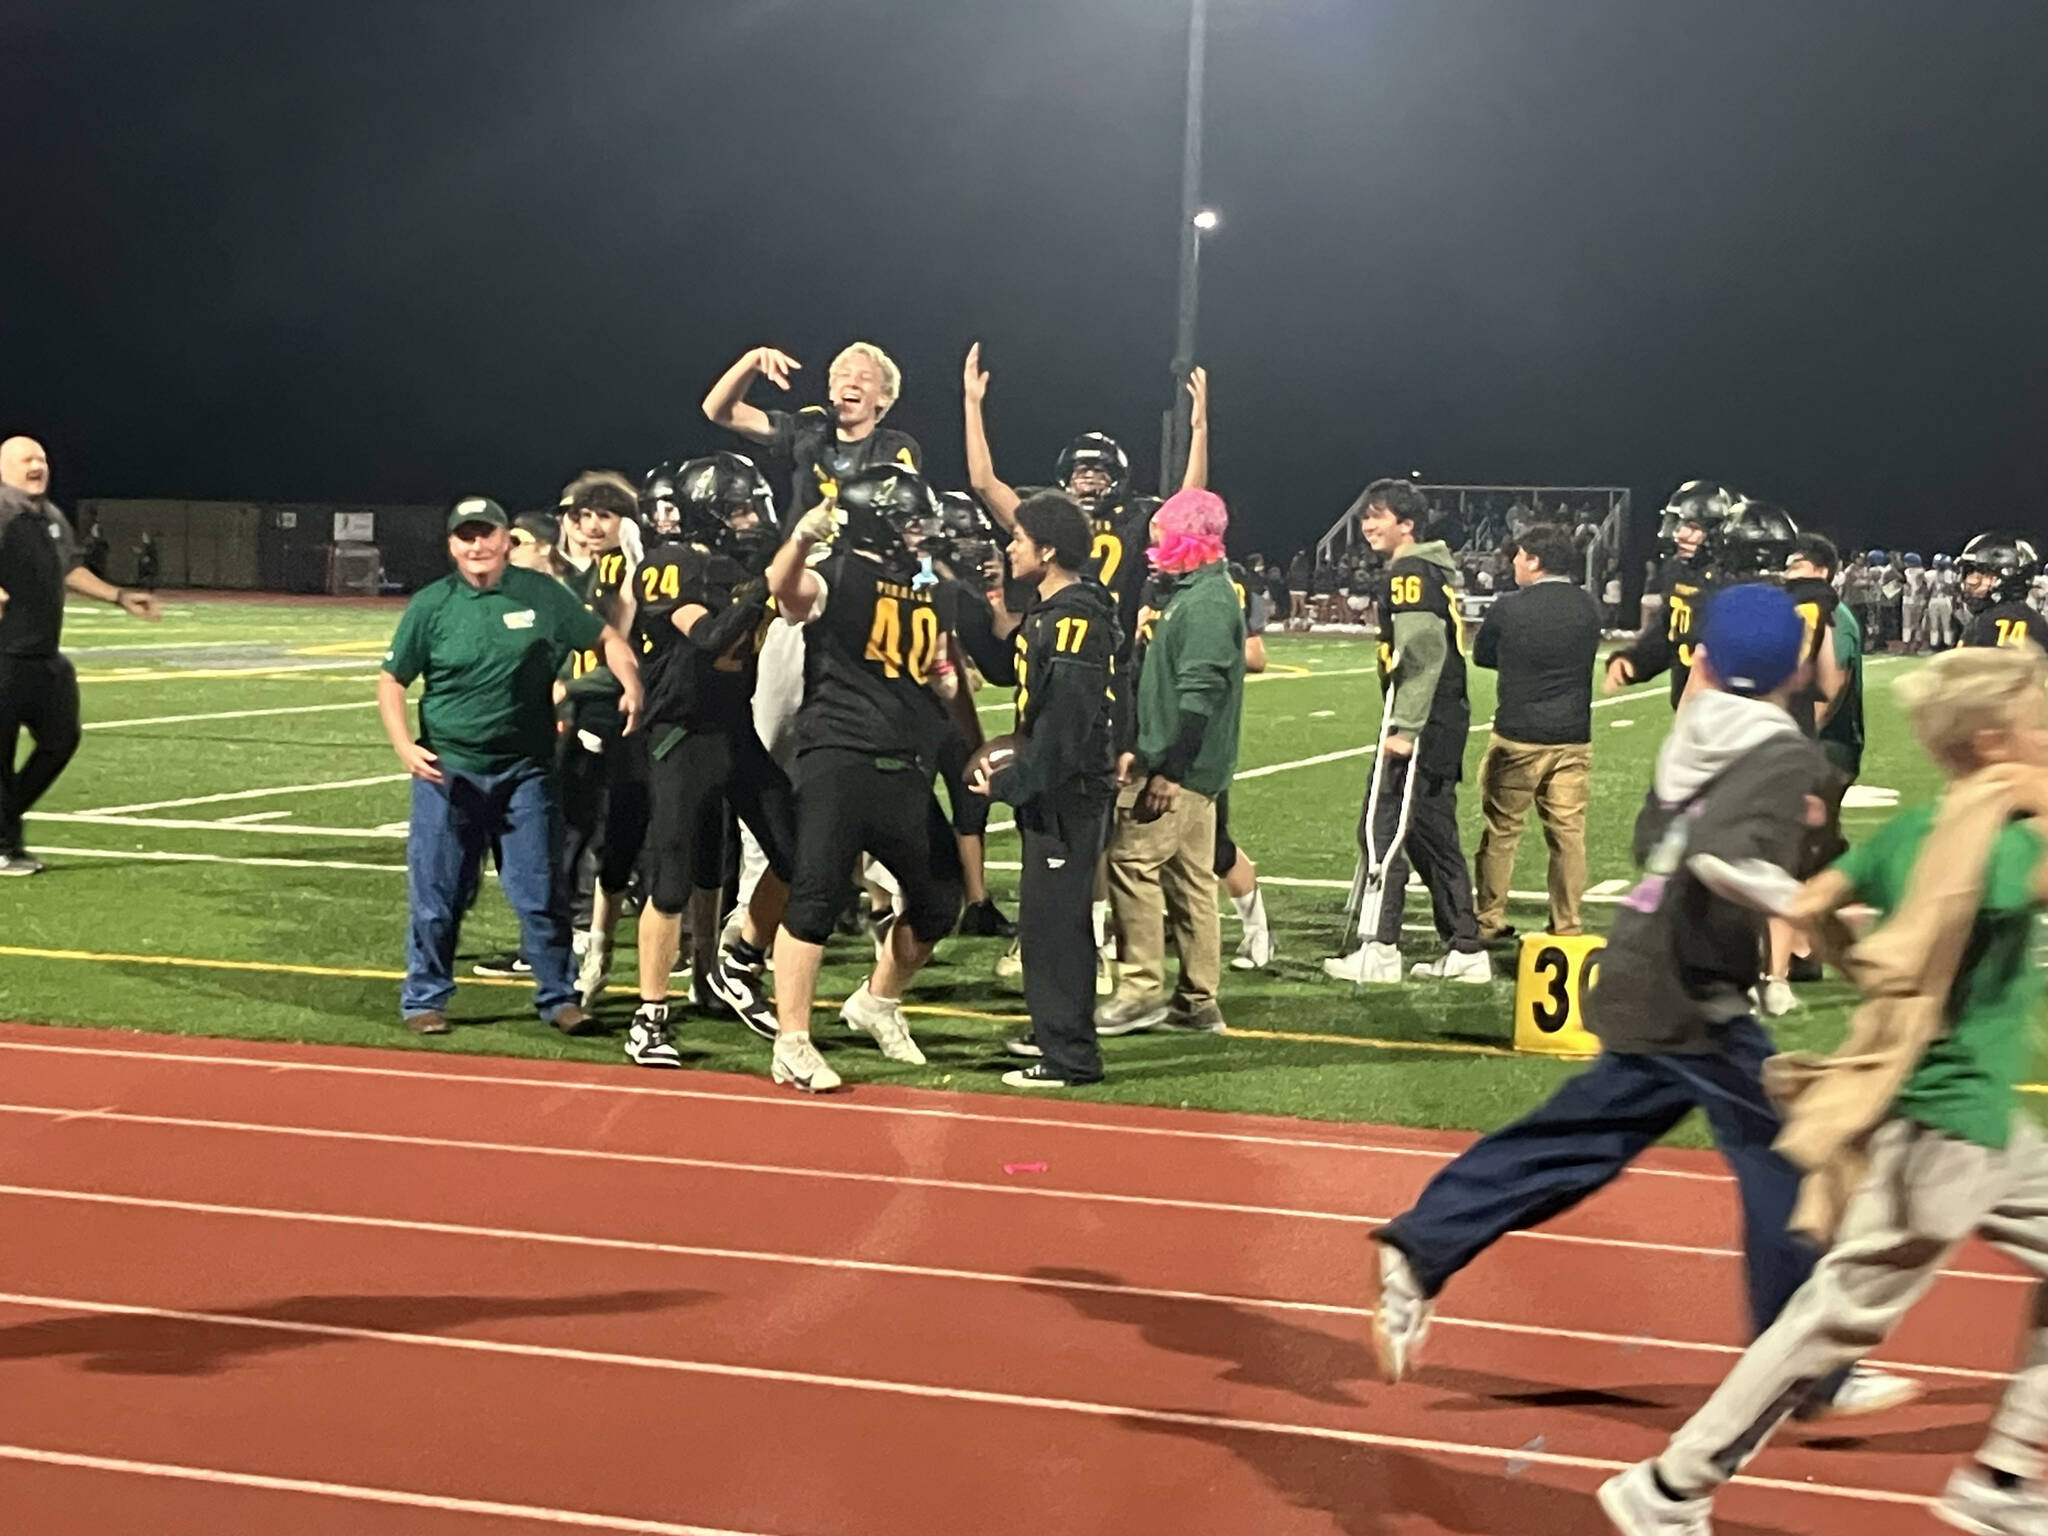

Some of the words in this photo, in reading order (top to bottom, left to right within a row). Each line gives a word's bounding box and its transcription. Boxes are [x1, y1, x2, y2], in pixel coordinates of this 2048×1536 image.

[642, 564, 680, 601] 24
[1391, 575, 1421, 605] 56
[864, 597, 937, 685] 40
[1055, 617, 1088, 653] 17
[1995, 619, 2027, 649] 74
